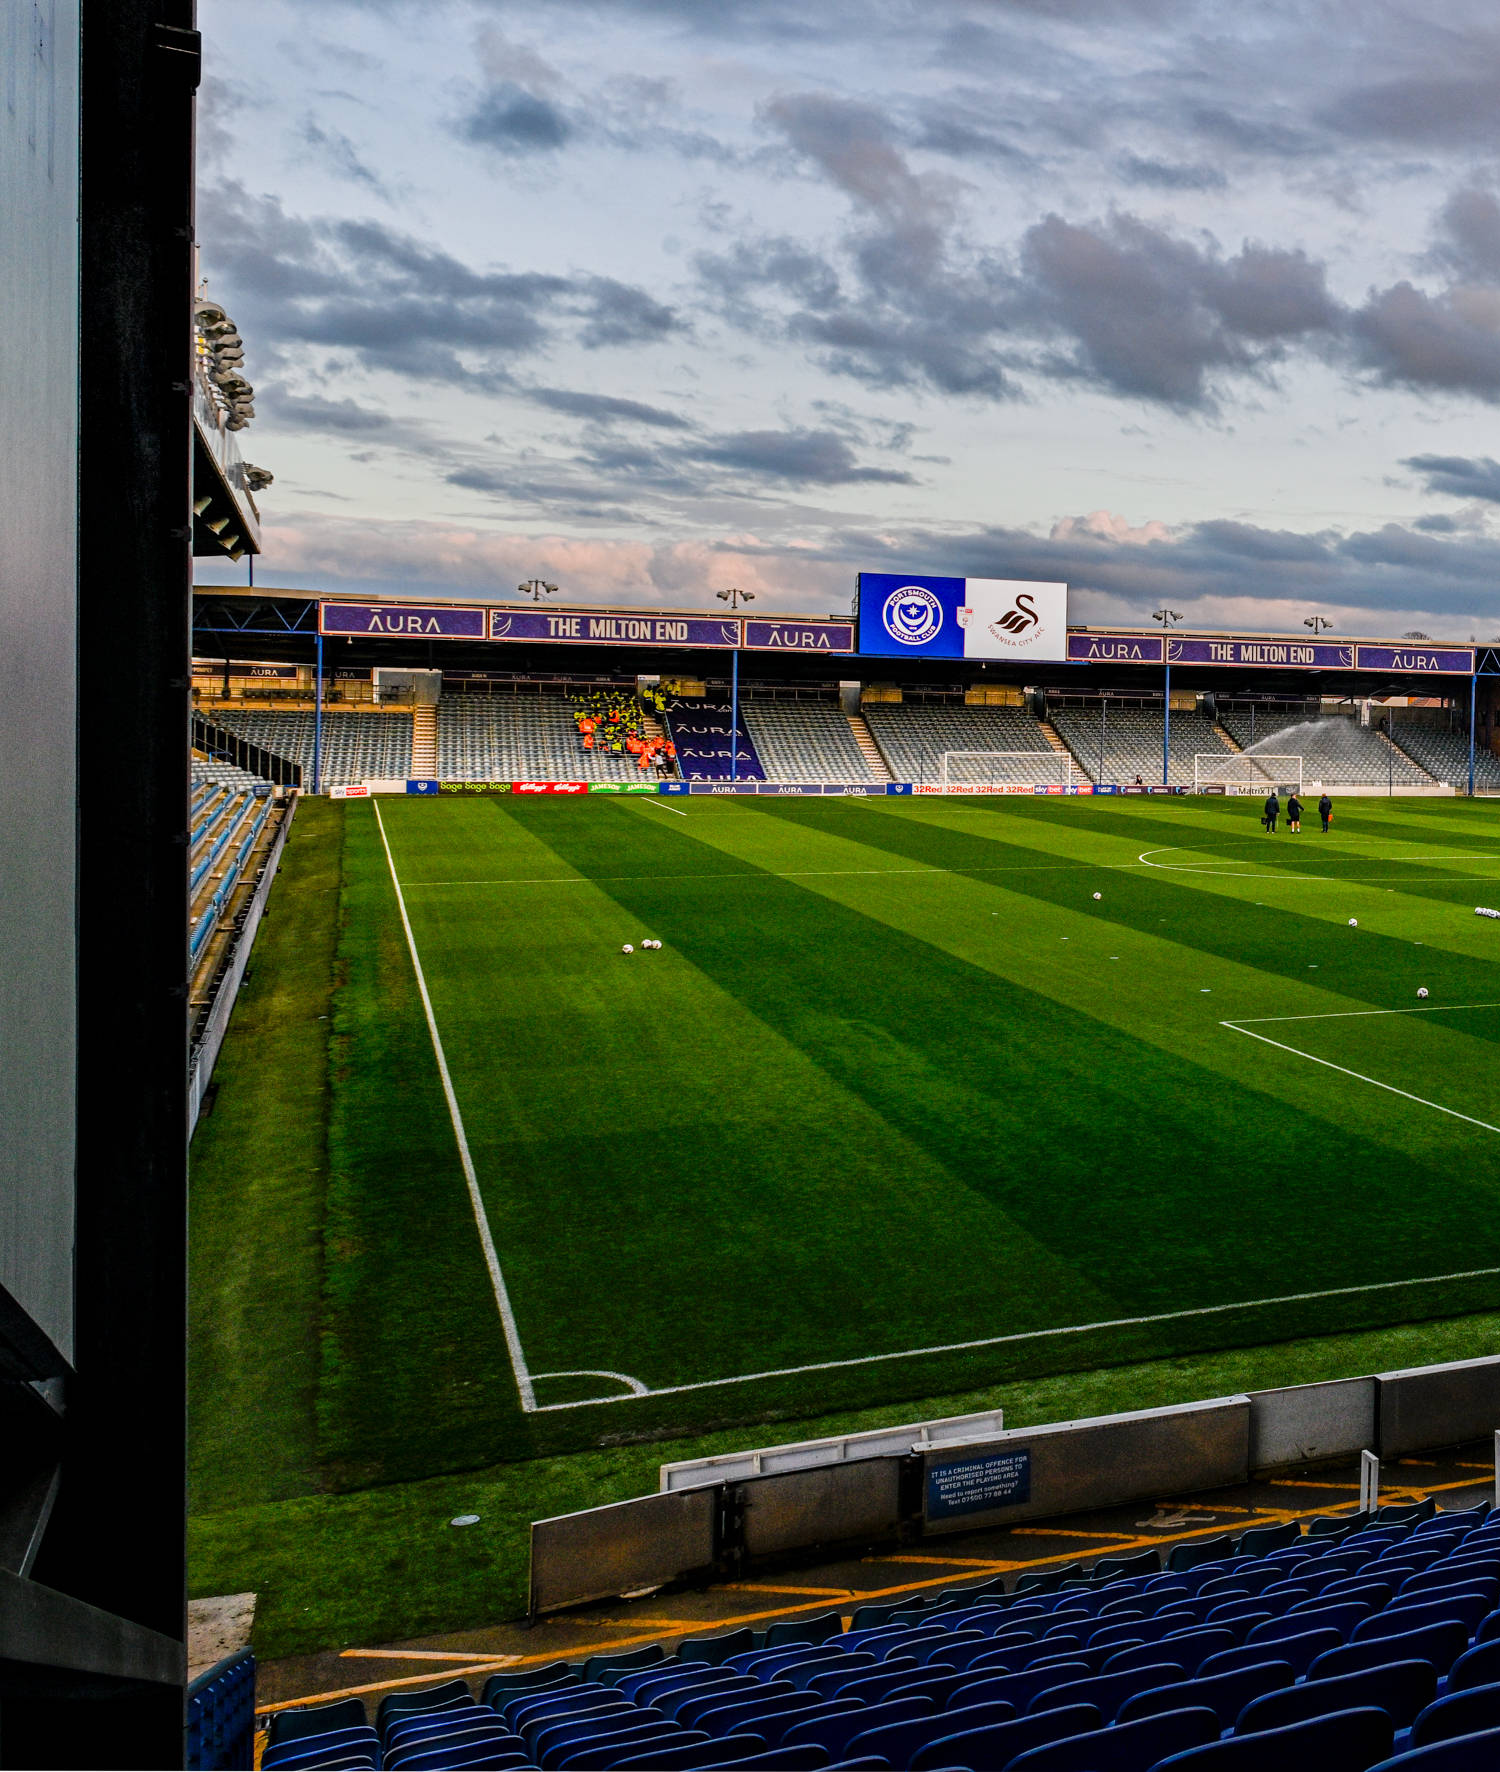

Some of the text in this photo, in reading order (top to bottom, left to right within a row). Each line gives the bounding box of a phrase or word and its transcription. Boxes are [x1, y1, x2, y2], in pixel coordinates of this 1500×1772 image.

[889, 589, 937, 609] PORTSMOUTH
[547, 617, 688, 641] THE MILTON END
[889, 623, 937, 641] FOOTBALL CLUB
[987, 624, 1046, 647] SWANSEA CITY AFC
[1209, 643, 1315, 664] THE MILTON END
[334, 786, 368, 797] sky sports
[440, 781, 511, 793] Sage Sage Sage
[590, 783, 657, 792] JAMESON JAMESON
[913, 785, 1034, 794] 32Red 32Red 32Red 32Red
[1035, 785, 1063, 795] sky bet
[1079, 785, 1092, 794] bet
[935, 1470, 984, 1485] UNAUTHORISED
[984, 1464, 1014, 1476] PERSONS
[953, 1464, 985, 1475] CRIMINAL
[985, 1458, 1014, 1469] OFFENCE
[940, 1471, 1019, 1491] ENTER THE PLAYING AREA
